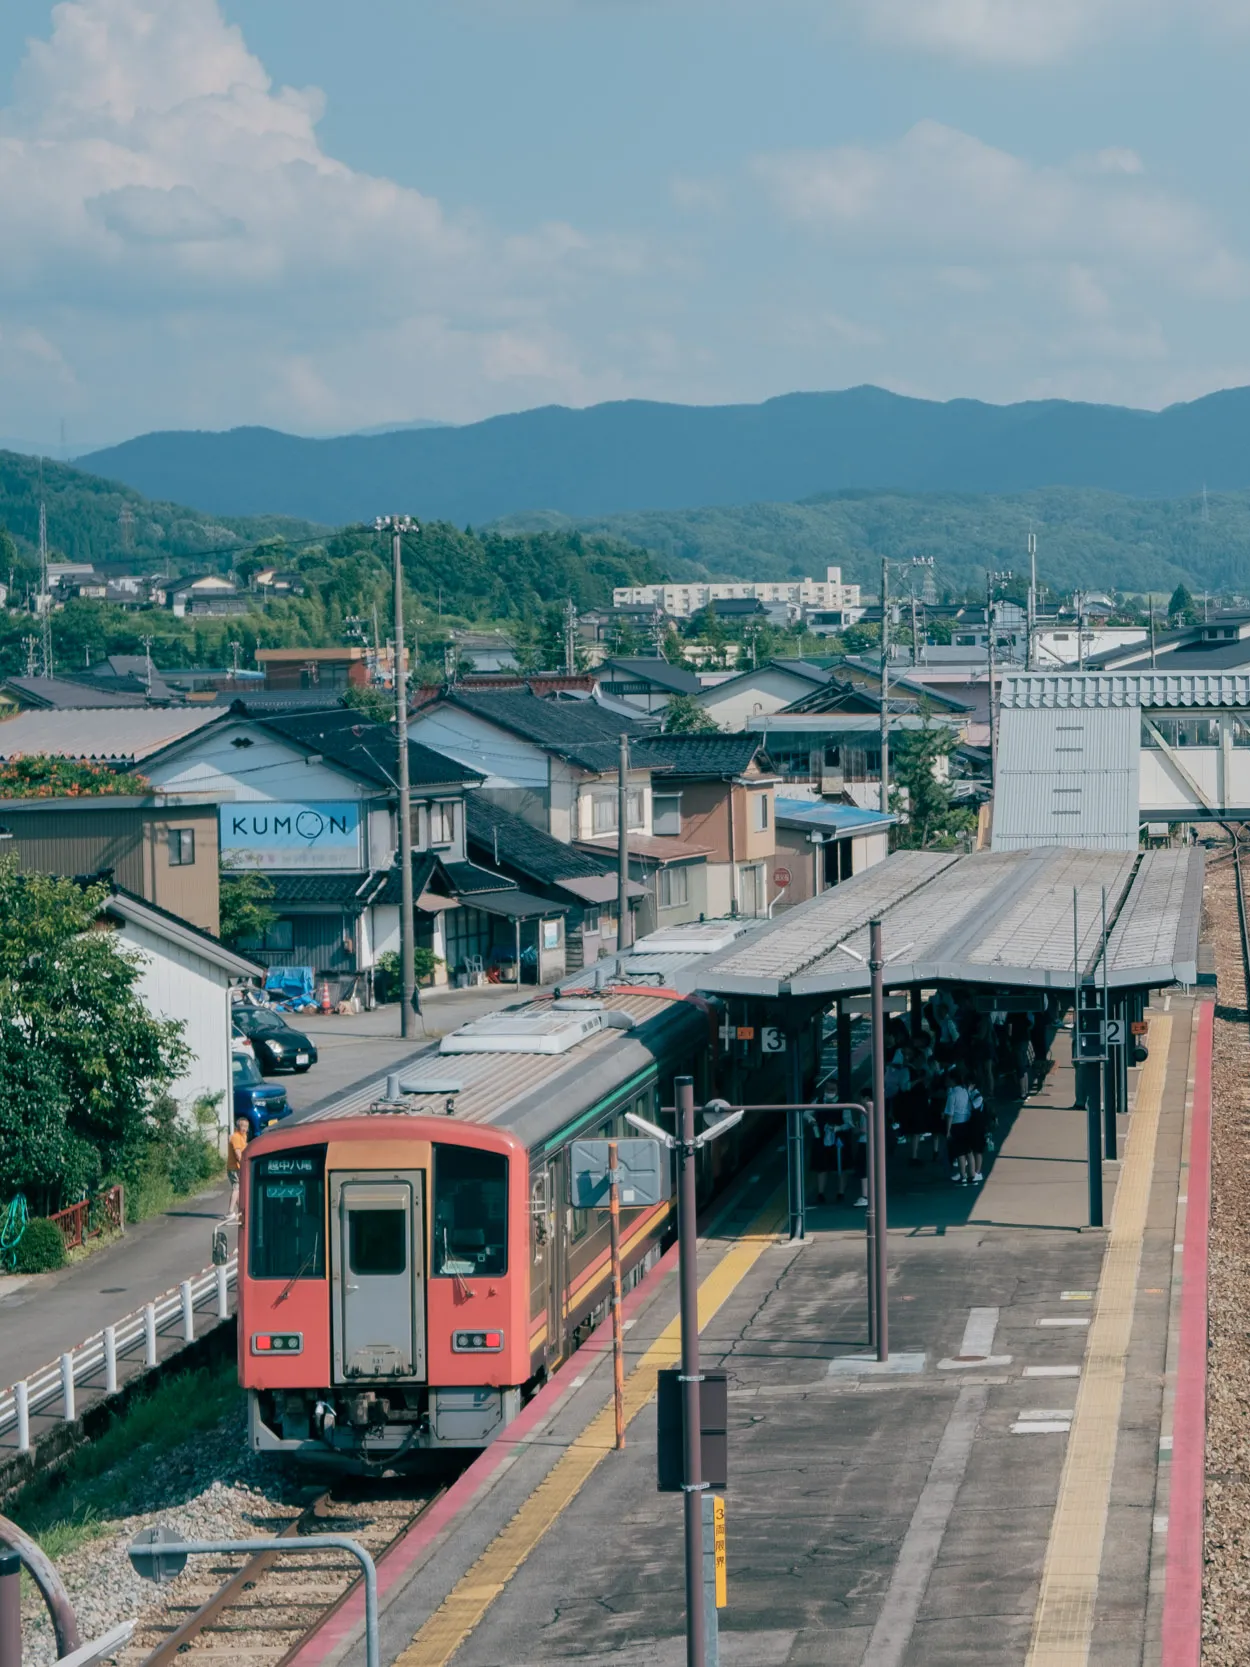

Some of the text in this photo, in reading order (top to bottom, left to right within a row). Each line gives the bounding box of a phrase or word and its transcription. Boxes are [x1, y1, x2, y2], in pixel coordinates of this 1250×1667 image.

[232, 811, 347, 839] KUMON
[767, 1028, 783, 1050] 3
[1107, 1021, 1120, 1043] 2
[267, 1159, 313, 1171] 越中八尾
[715, 1508, 725, 1568] 3両限界
